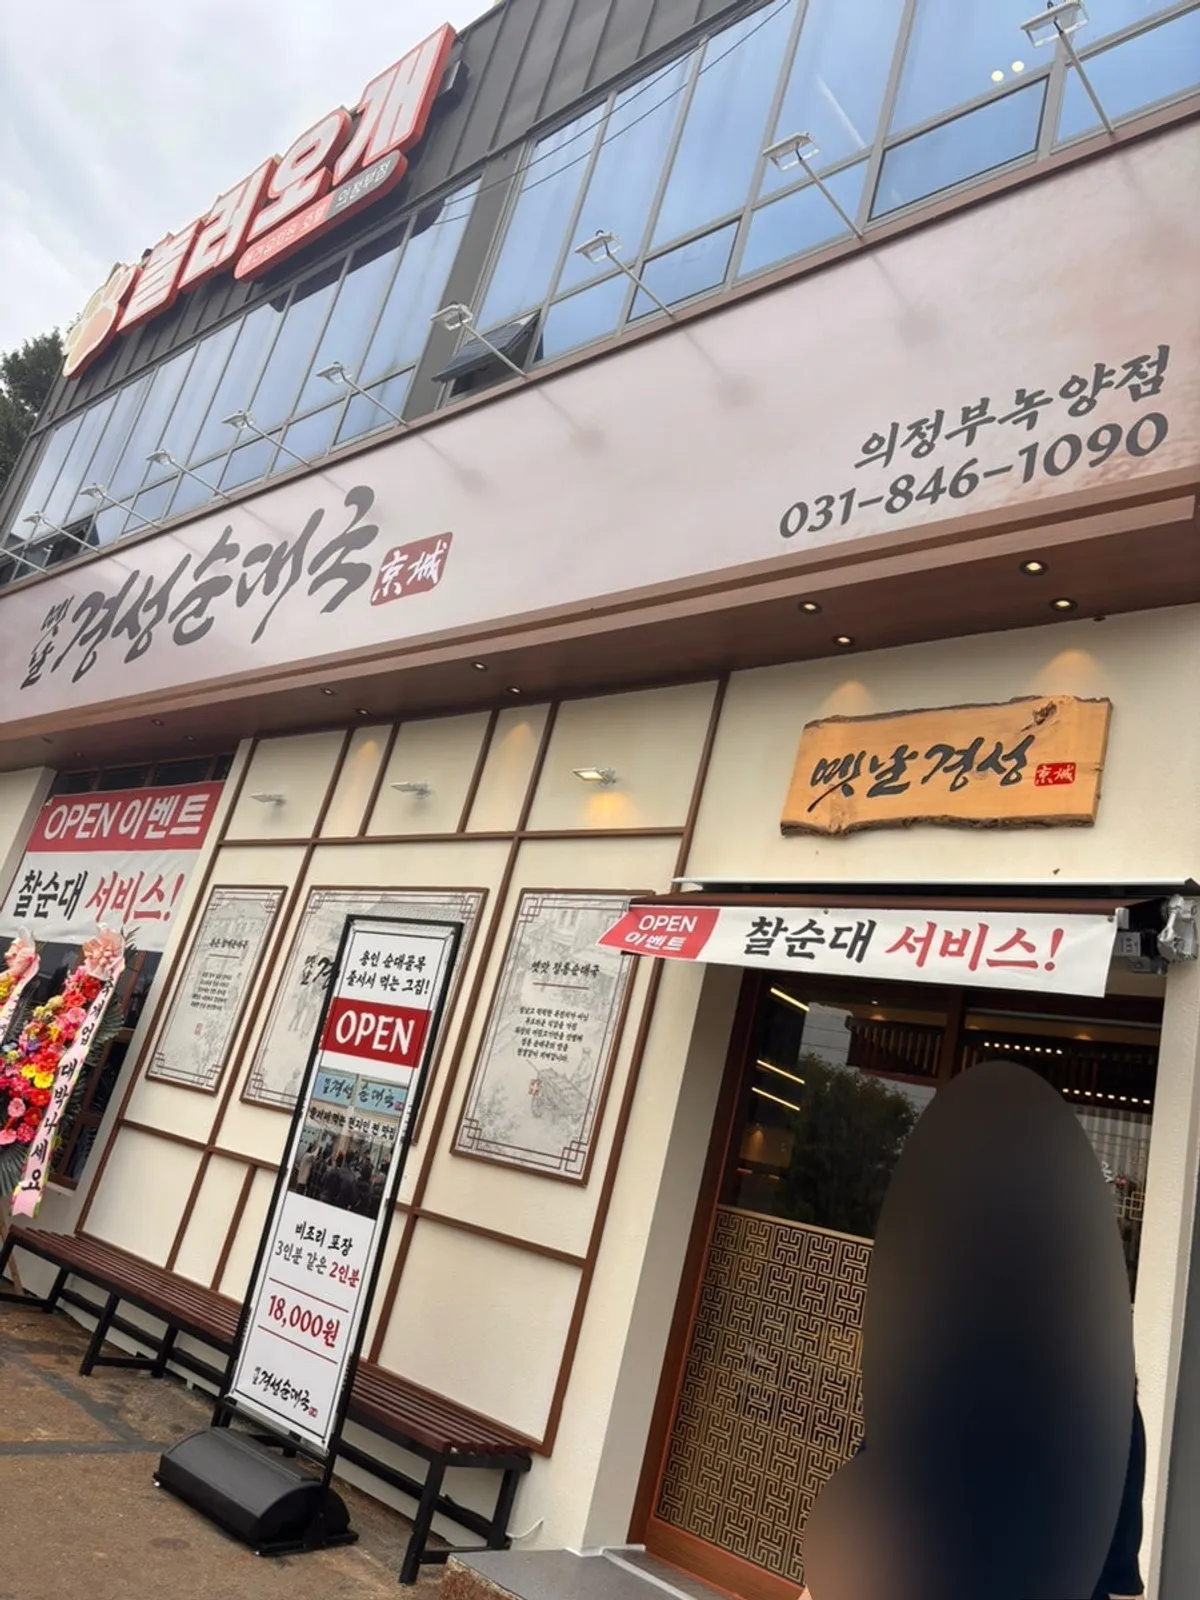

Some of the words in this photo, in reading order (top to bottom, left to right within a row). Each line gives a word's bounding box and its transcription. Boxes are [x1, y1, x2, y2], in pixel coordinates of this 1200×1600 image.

[779, 412, 1169, 538] 031-846-1090
[52, 485, 380, 683] 경성순대국
[44, 802, 119, 840] OPEN
[118, 794, 210, 840] 이벤트
[13, 870, 88, 921] 찰순대
[85, 871, 185, 925] 서비스!
[624, 931, 688, 952] 이벤트
[638, 914, 699, 933] OPEN
[743, 916, 878, 964] 찰순대
[885, 920, 1065, 972] 서비스!
[346, 969, 377, 989] 줄서서
[379, 974, 400, 992] 먹는
[401, 977, 431, 996] 그집!
[359, 950, 381, 968] 용인
[383, 953, 427, 973] 순대골목
[335, 1010, 416, 1056] OPEN
[295, 1221, 327, 1248] 비조리
[328, 1234, 353, 1257] 포장
[275, 1240, 303, 1265] 3인분
[306, 1252, 327, 1275] 같은
[329, 1261, 360, 1288] 2인분
[268, 1294, 340, 1348] 18,000원
